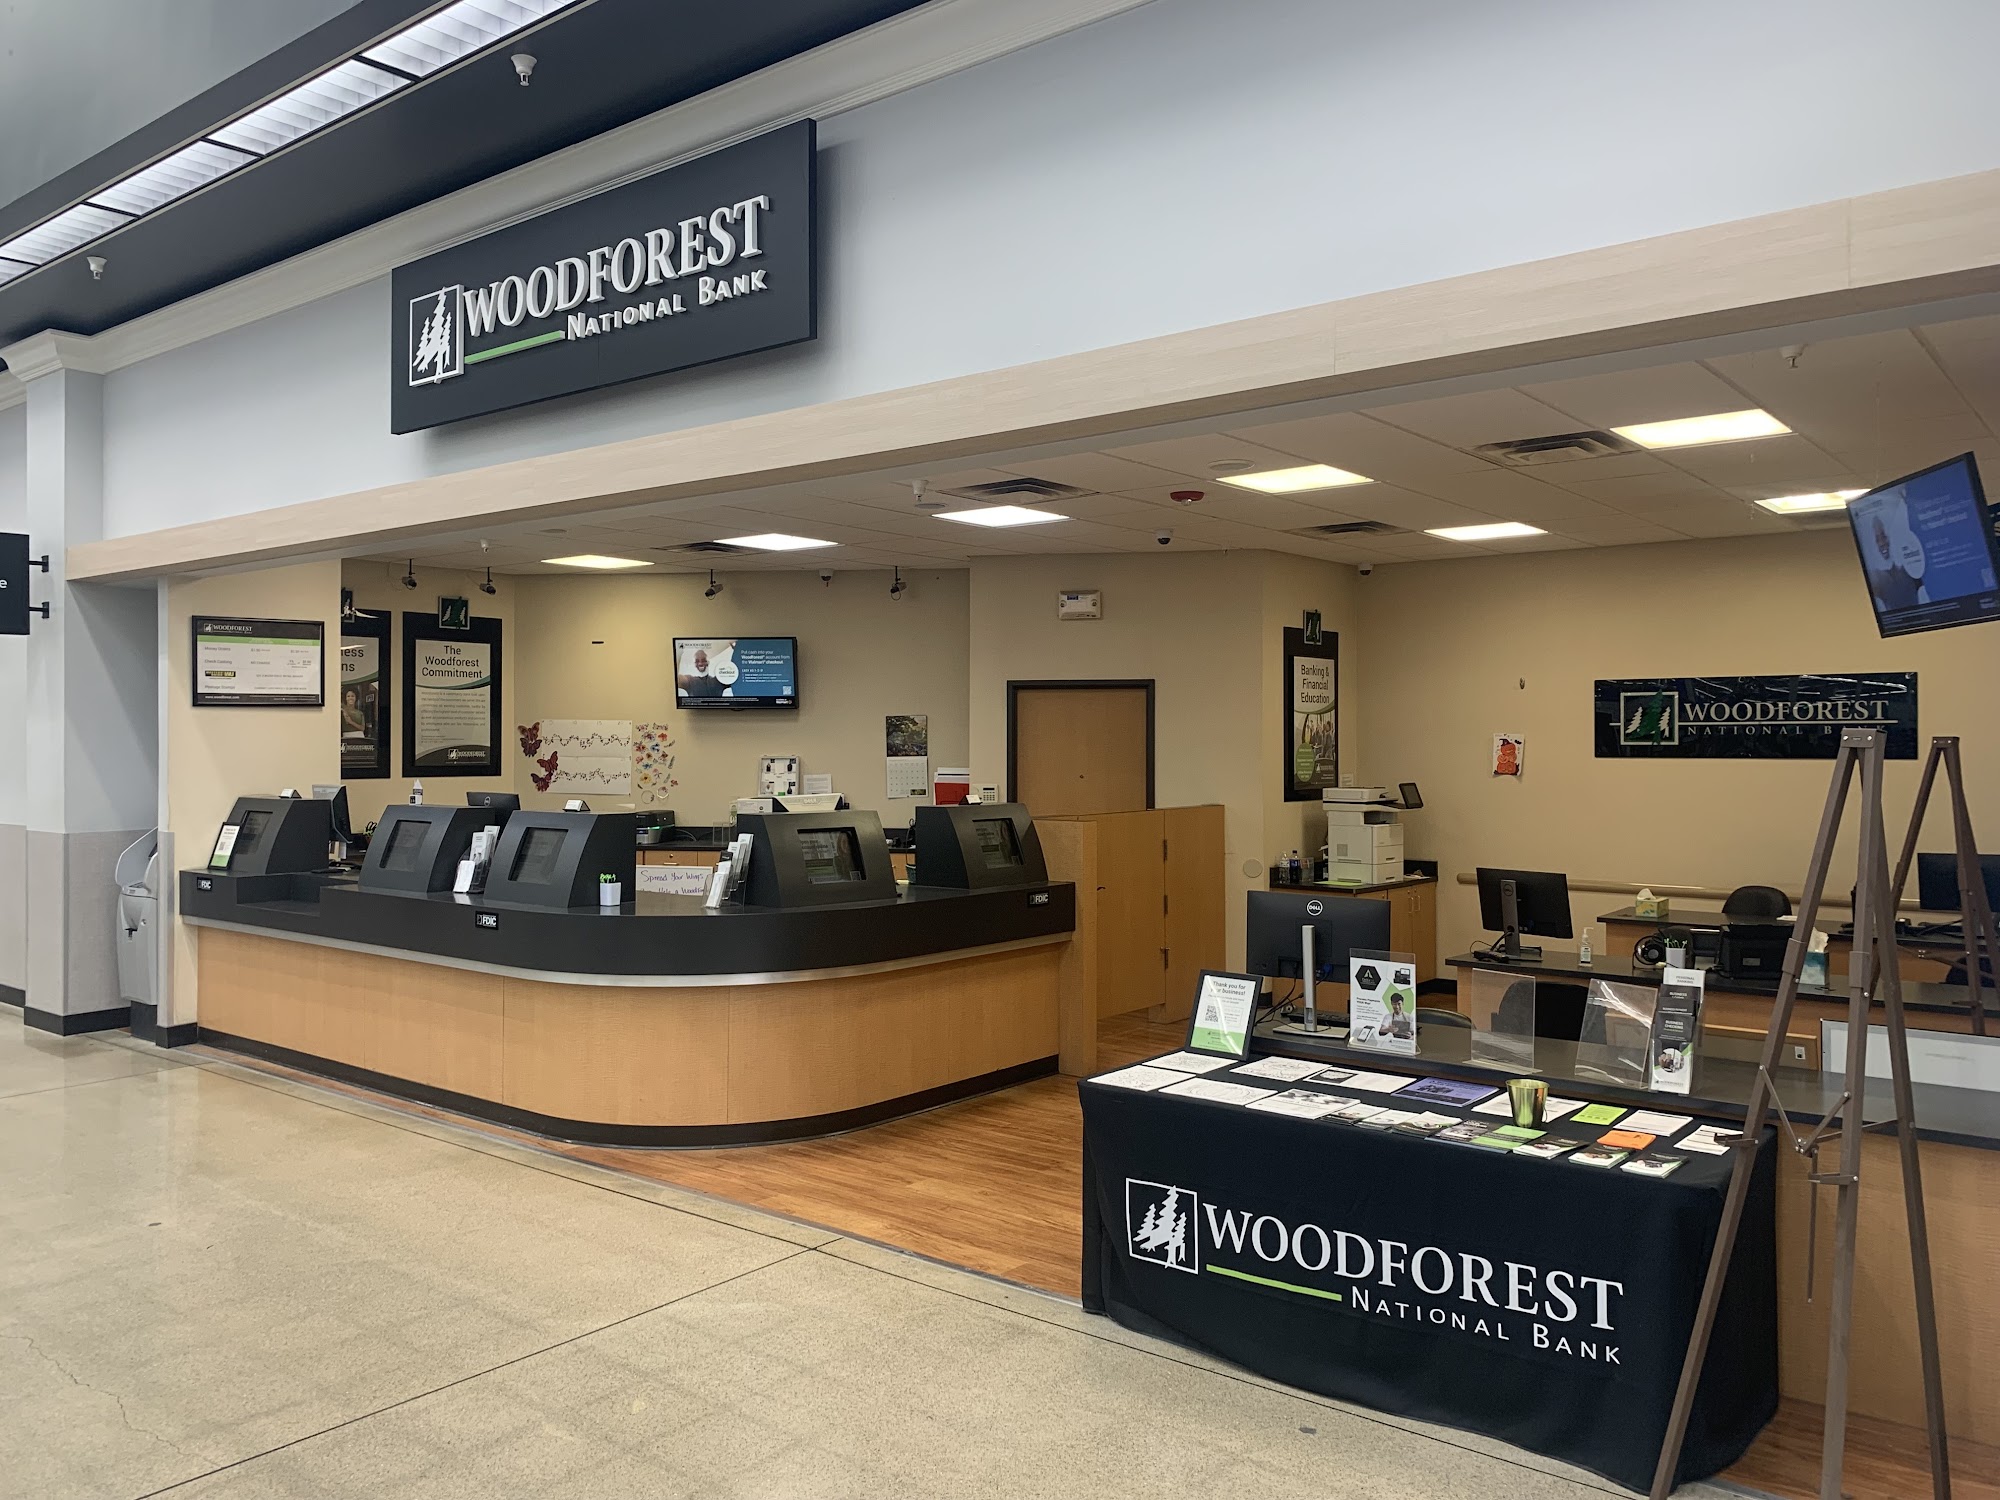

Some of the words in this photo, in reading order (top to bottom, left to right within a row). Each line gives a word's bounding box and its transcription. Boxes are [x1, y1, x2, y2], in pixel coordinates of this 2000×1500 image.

[463, 194, 770, 336] WOODFOREST
[213, 624, 253, 632] WOODFOREST
[444, 645, 462, 655] The
[425, 656, 480, 667] Woodforest
[421, 667, 483, 679] Commitment
[1300, 664, 1325, 679] Banking
[1325, 666, 1330, 677] &
[1302, 678, 1329, 690] Financial
[1300, 692, 1330, 704] Education
[1684, 700, 1889, 721] WOODFOREST
[1688, 725, 1804, 736] NATIONAL
[1035, 894, 1048, 902] FDIC
[482, 915, 497, 926] FDIC
[1221, 988, 1246, 996] business!
[1203, 1202, 1624, 1331] WOODFOREST
